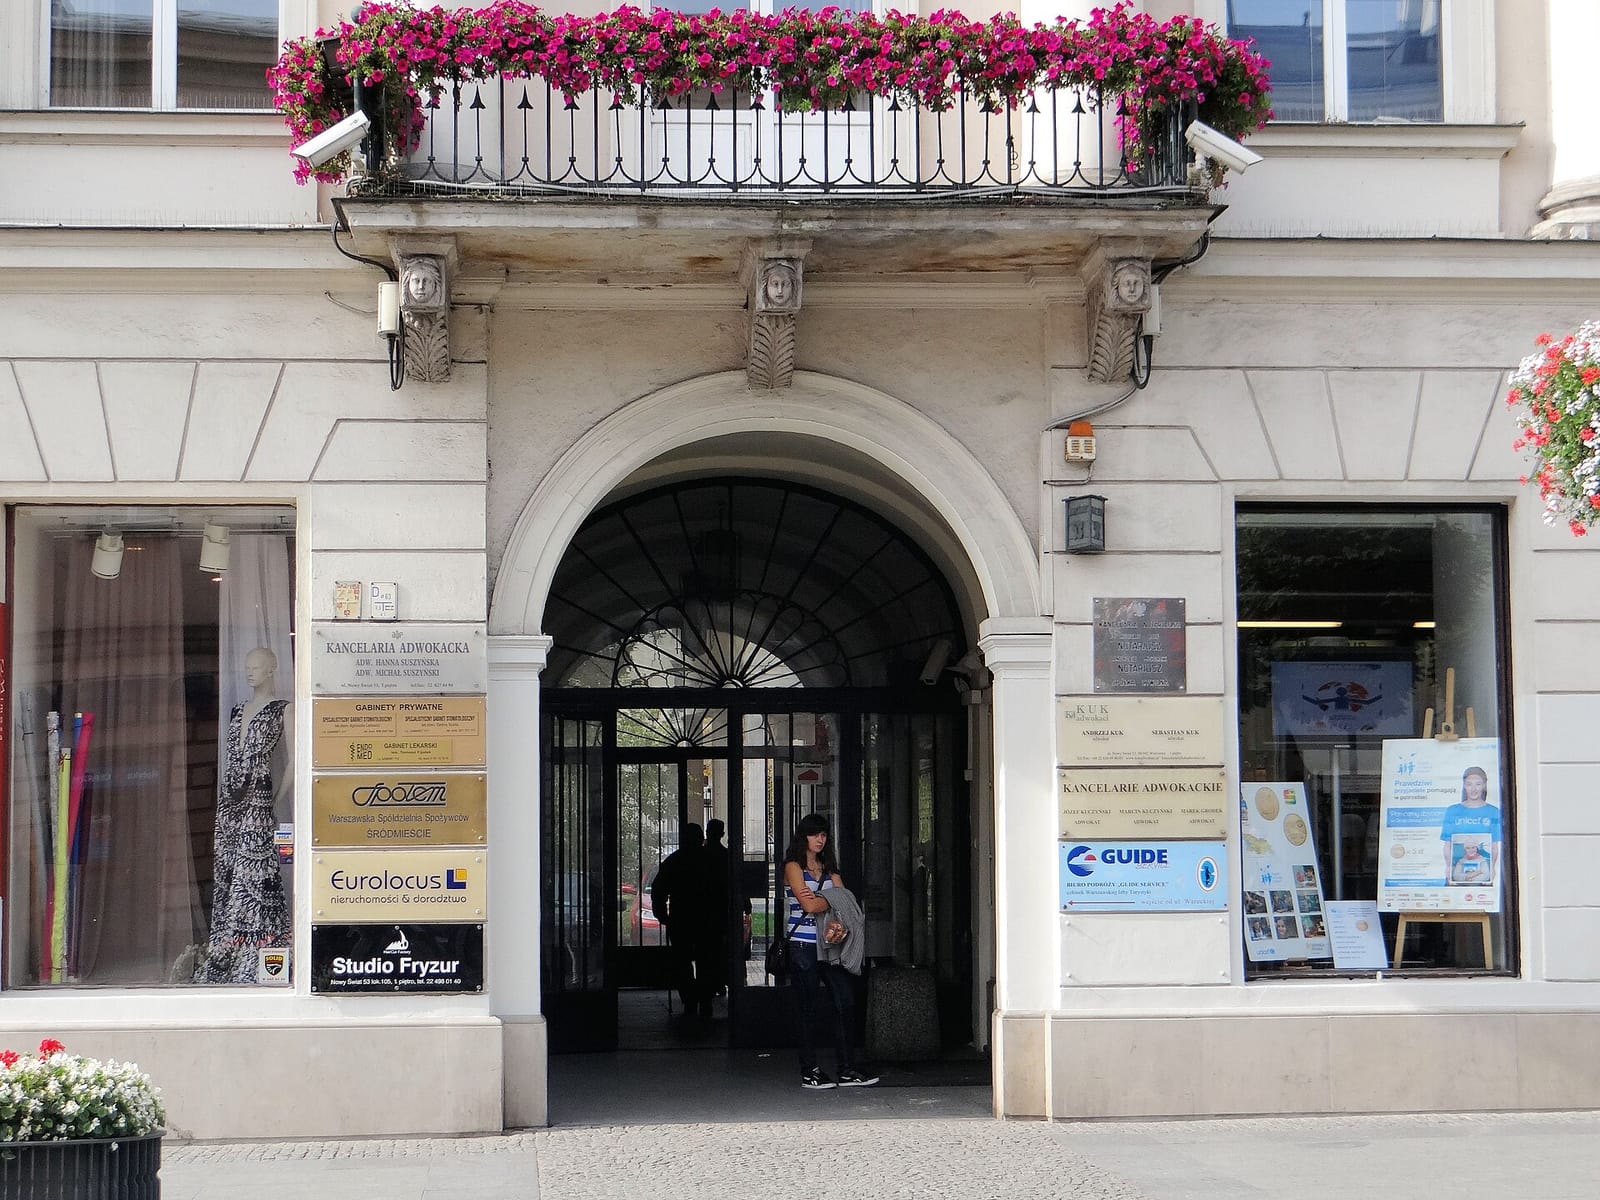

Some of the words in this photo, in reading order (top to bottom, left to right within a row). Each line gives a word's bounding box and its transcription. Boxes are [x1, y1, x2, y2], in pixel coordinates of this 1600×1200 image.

[326, 642, 396, 654] KANCELARIA
[400, 642, 470, 654] ADWOKACKA
[400, 657, 440, 666] SUSZYŃSKA
[403, 668, 440, 676] SUSZYŃSKI
[357, 751, 372, 760] MED
[1063, 783, 1139, 793] KANCELARIE
[1142, 783, 1222, 792] ADWOKACKIE
[328, 814, 375, 823] Warszawska
[378, 813, 422, 824] Spółdzielnia
[425, 813, 469, 824] Spożywców
[1455, 817, 1480, 826] unicef
[367, 828, 431, 838] ŚRÓDMIEŚCIE
[1101, 849, 1168, 864] GUIDE
[331, 870, 441, 889] Eurolocus
[331, 895, 399, 904] nieruchomości
[402, 895, 410, 903] &
[413, 894, 466, 903] doradztwo
[333, 957, 394, 974] Studio
[400, 957, 460, 977] Fryzur
